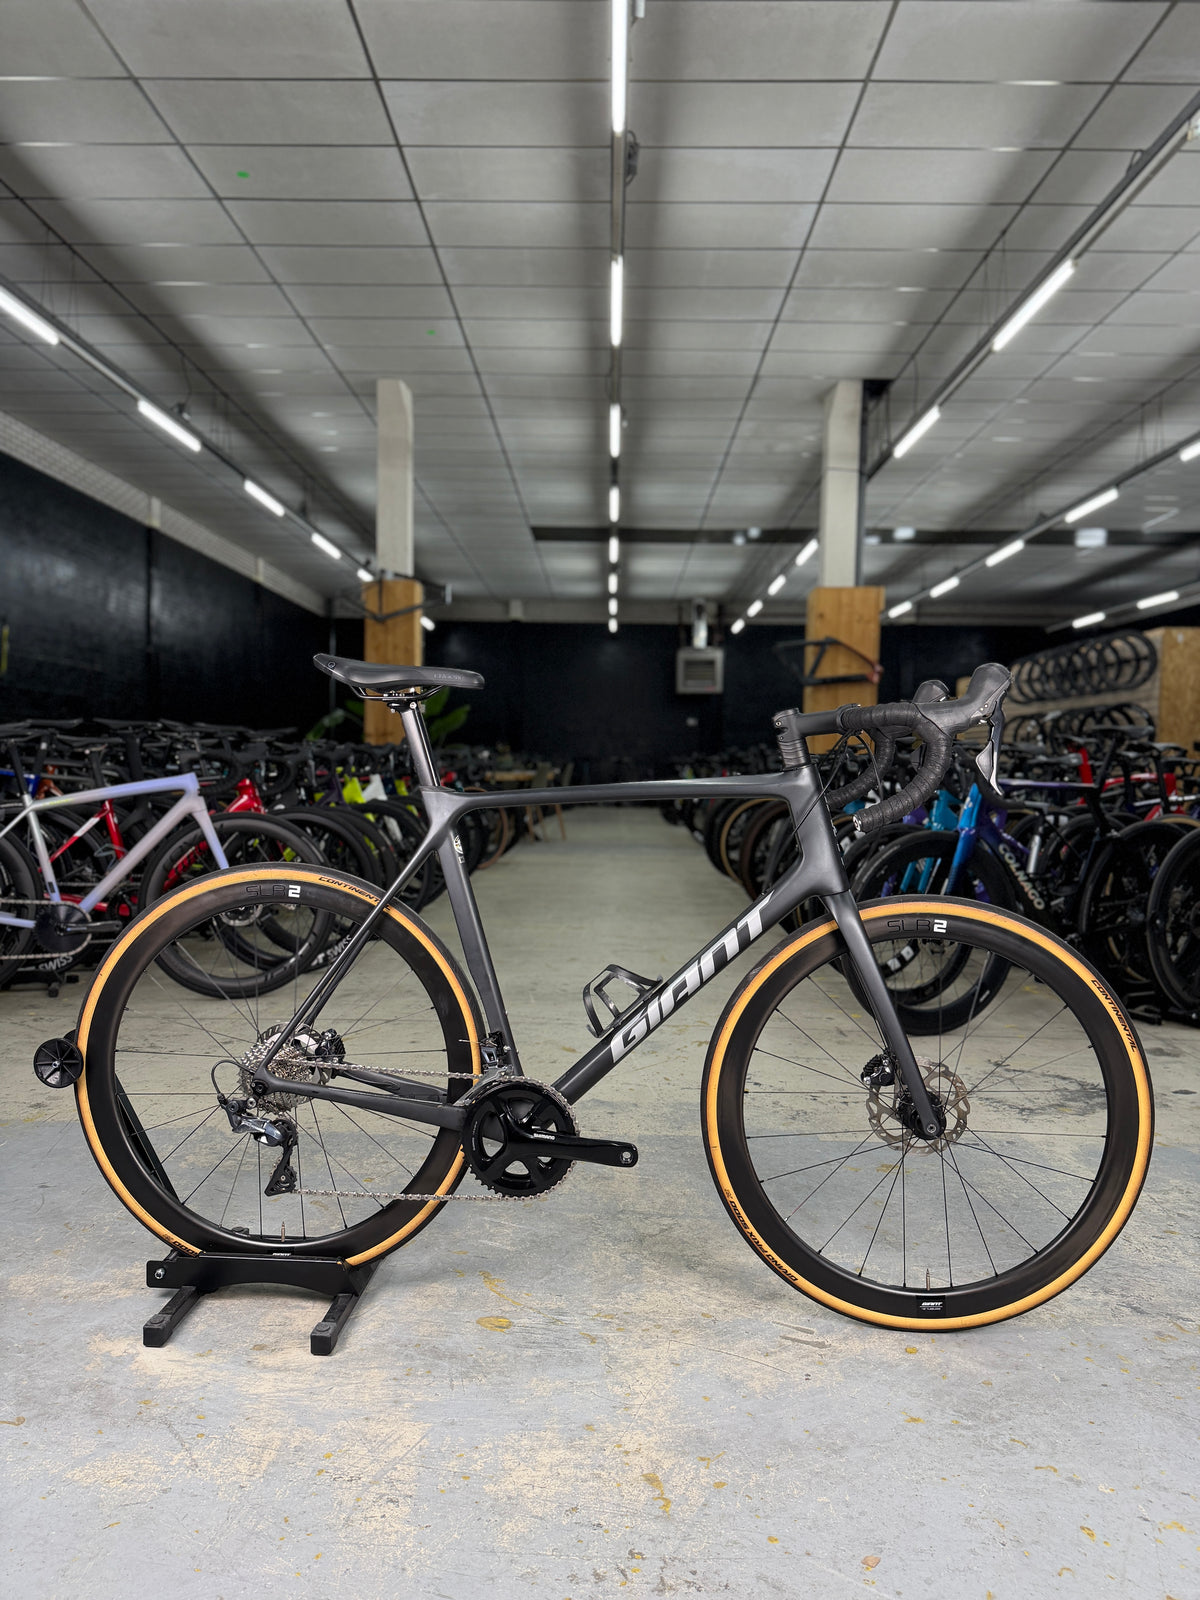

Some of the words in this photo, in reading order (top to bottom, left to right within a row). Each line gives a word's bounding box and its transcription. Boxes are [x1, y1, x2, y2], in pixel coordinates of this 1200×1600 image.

[998, 843, 1045, 910] COLNAGO
[610, 889, 775, 1064] GIANT
[1091, 979, 1137, 1053] CONTINENTAL
[730, 1200, 750, 1230] 5000
[747, 1230, 768, 1253] PRIX
[766, 1253, 798, 1282] GRAND
